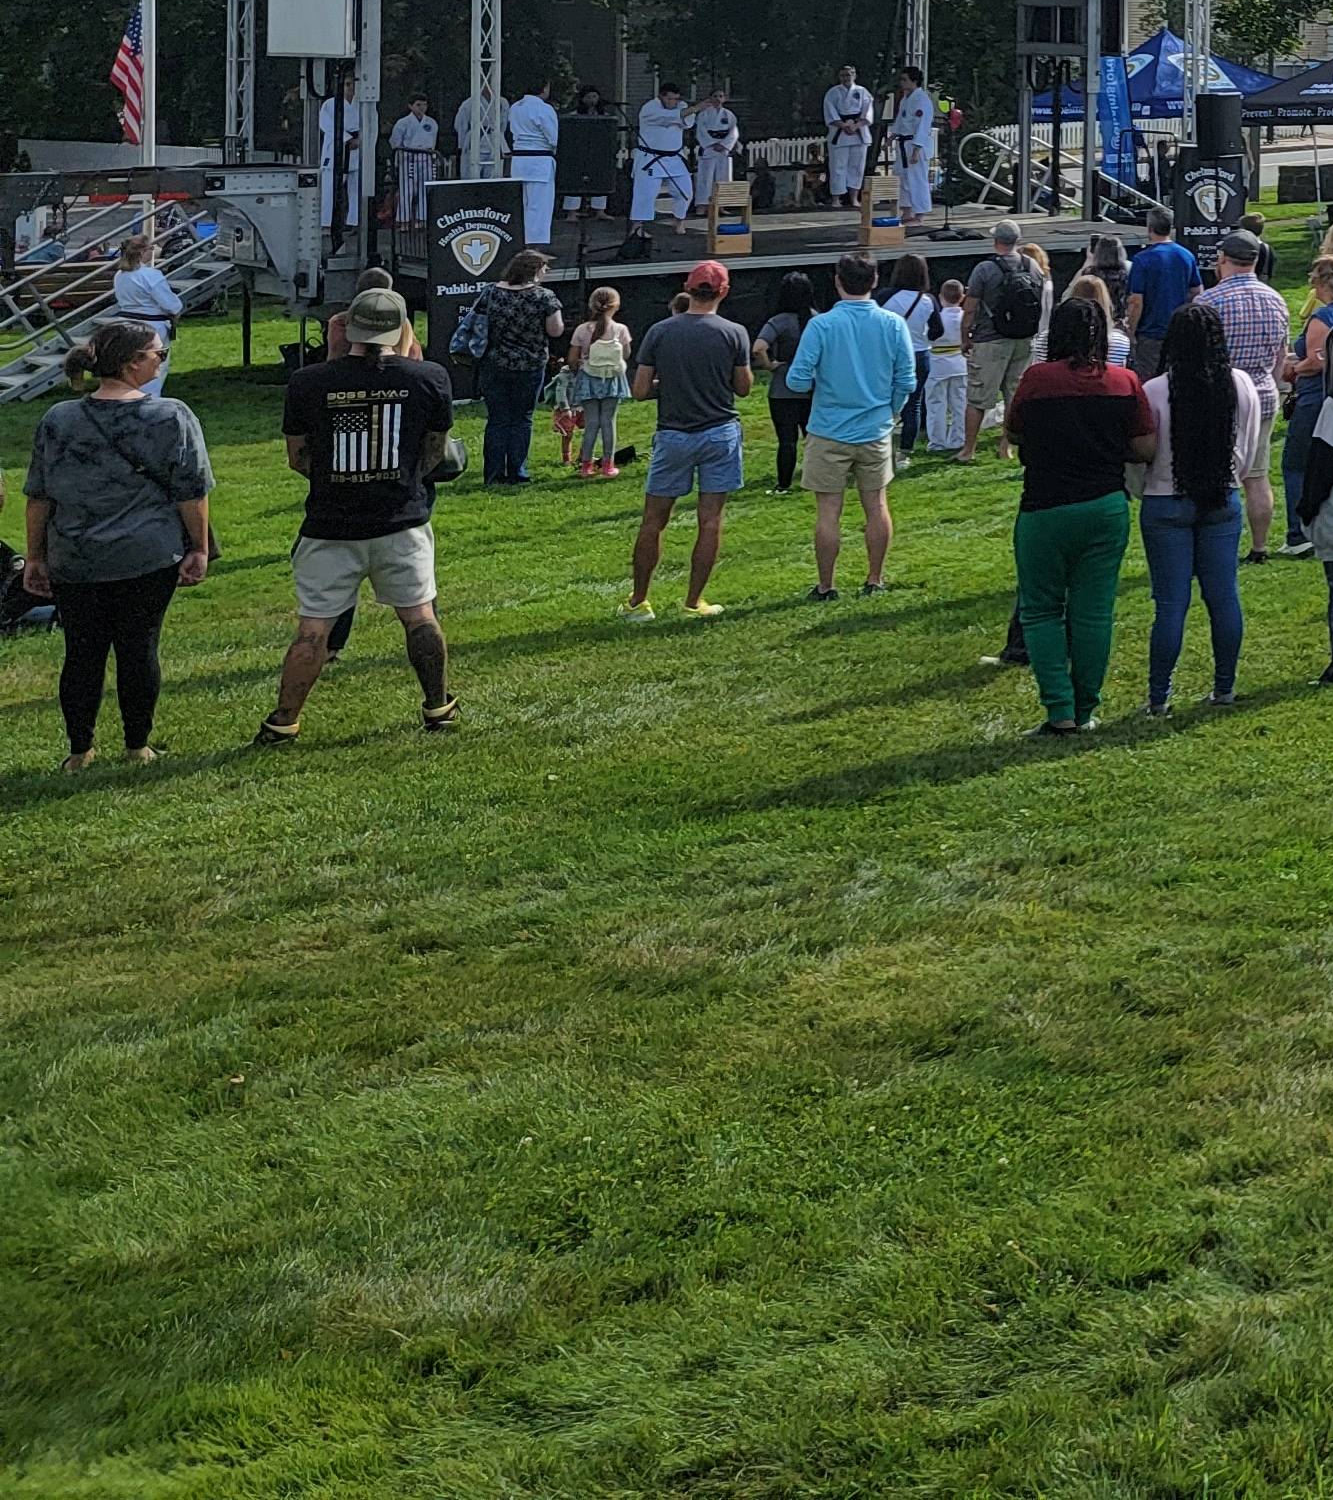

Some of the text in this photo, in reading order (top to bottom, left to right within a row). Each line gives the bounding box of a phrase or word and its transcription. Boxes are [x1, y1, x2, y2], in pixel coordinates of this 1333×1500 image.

[1241, 108, 1274, 118] Prevent.
[1277, 107, 1314, 117] Promote.
[436, 206, 512, 229] Chelmsford
[438, 222, 513, 247] Health Department
[436, 283, 476, 296] Public
[327, 391, 366, 400] BOSS
